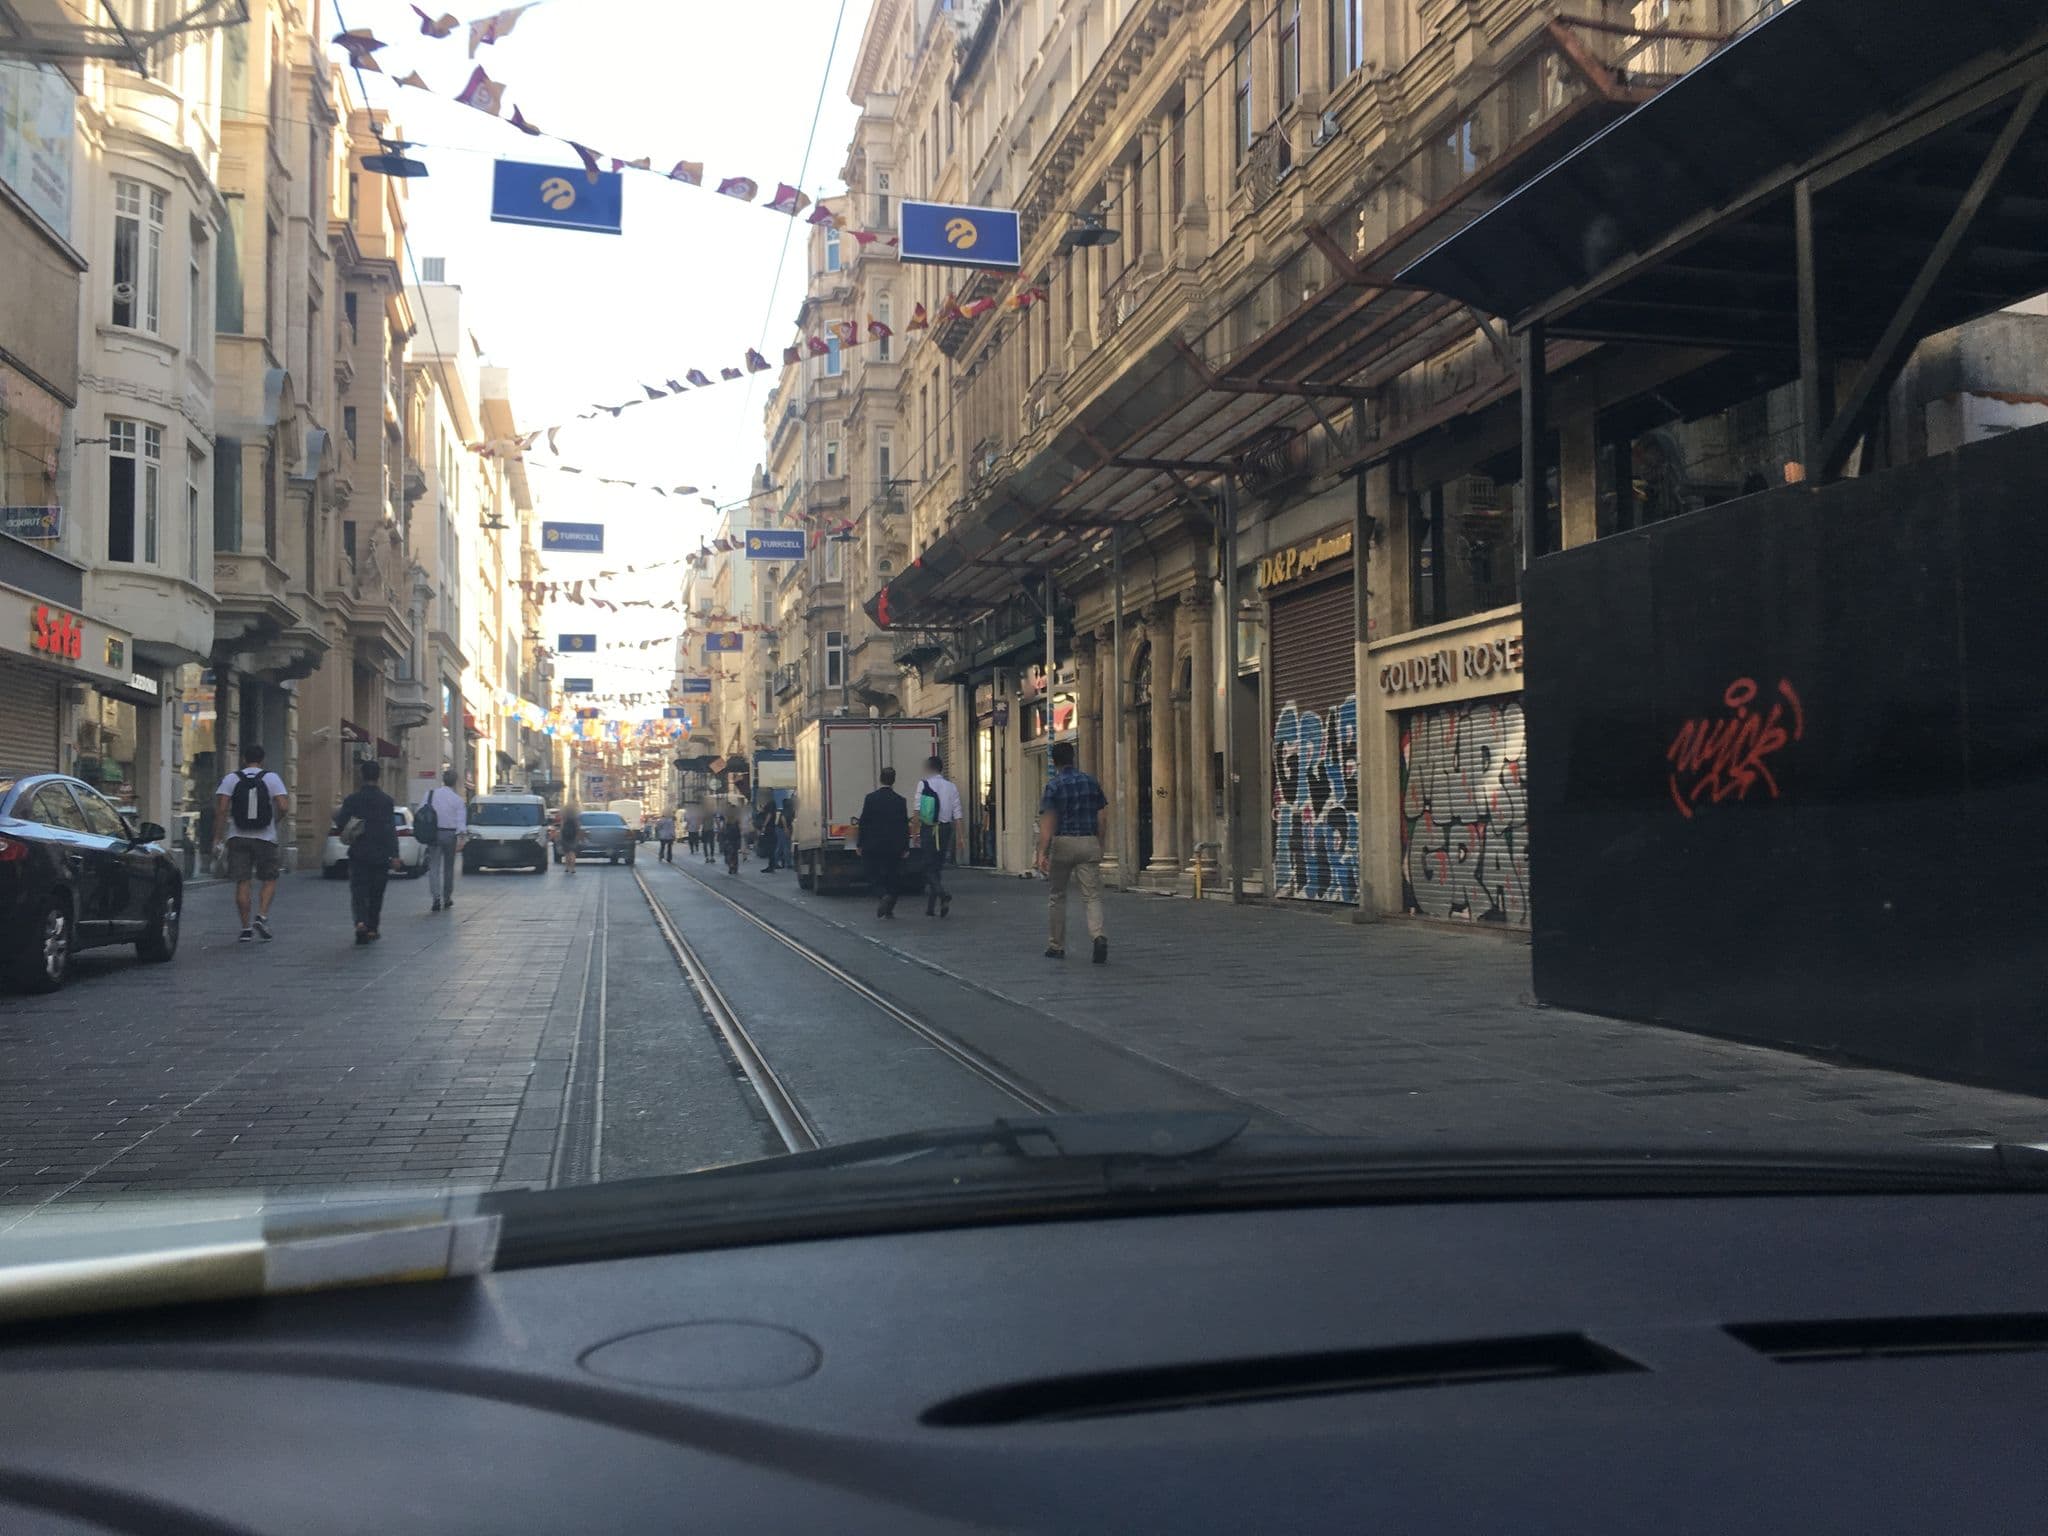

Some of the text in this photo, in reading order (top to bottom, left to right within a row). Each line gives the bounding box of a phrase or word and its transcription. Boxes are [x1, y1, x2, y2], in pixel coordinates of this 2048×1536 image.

[560, 532, 600, 541] TURKCELL
[762, 540, 801, 549] TURKCELL
[1261, 548, 1297, 589] D&P
[1379, 635, 1521, 694] GOLDEN ROSE
